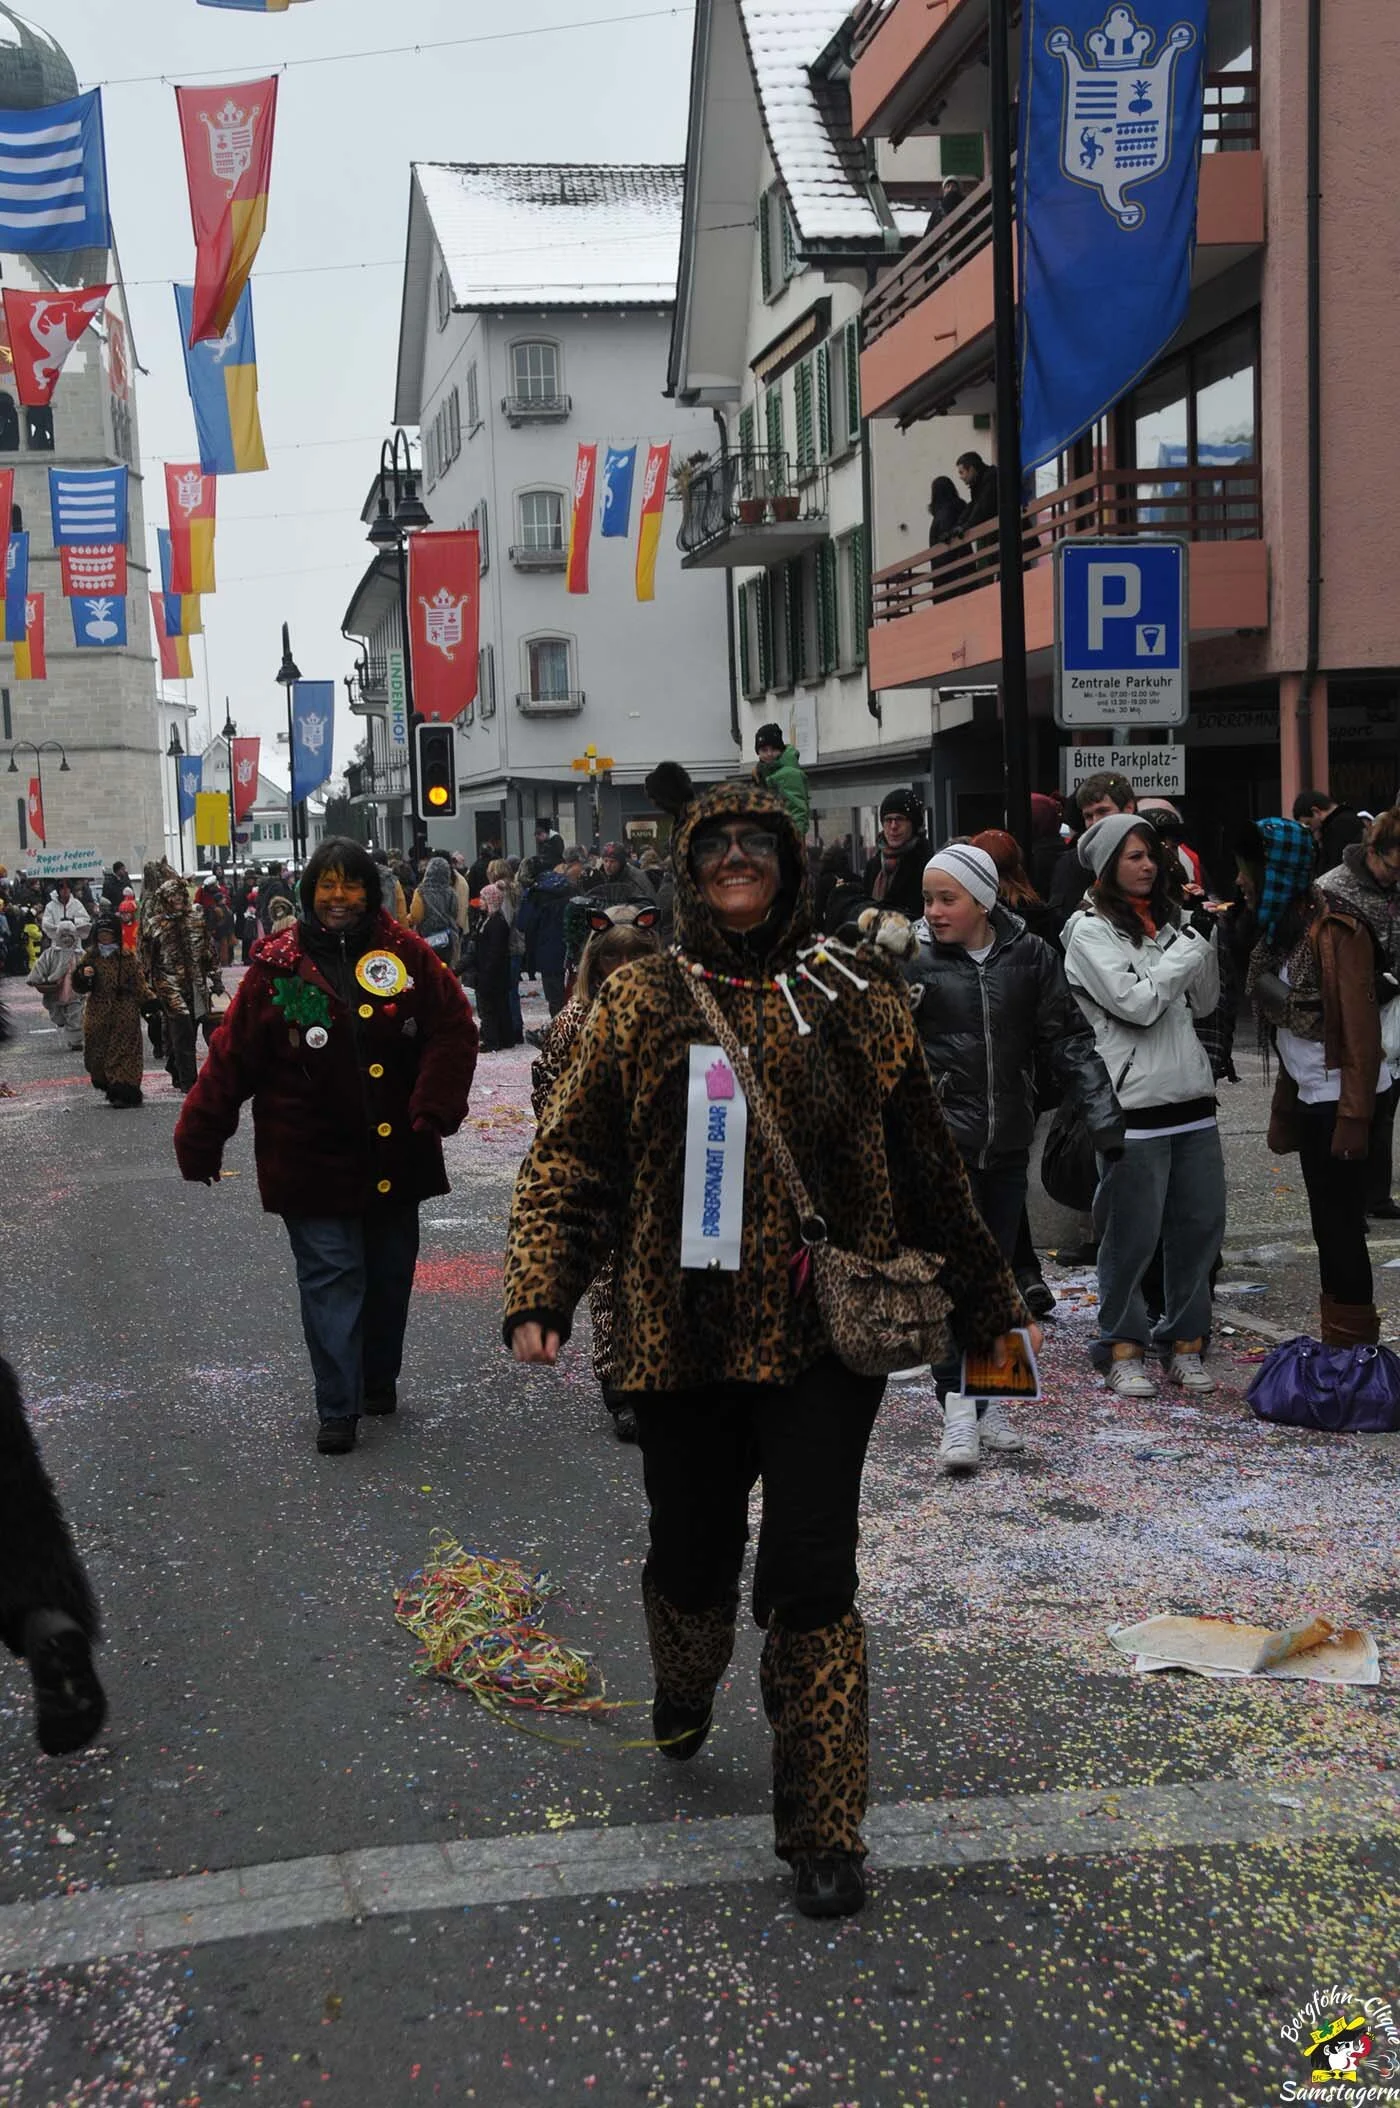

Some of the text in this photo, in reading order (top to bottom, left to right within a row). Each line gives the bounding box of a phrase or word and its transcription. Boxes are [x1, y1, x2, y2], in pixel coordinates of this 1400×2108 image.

[1088, 562, 1141, 651] P
[1071, 676, 1173, 689] Zentrale Parkuhr
[390, 653, 405, 745] LINDENHOF
[1074, 751, 1177, 770] Bitte Parkplatz-
[1132, 772, 1179, 788] merken
[36, 850, 96, 864] Roger Federer
[708, 1105, 727, 1142] BAAR
